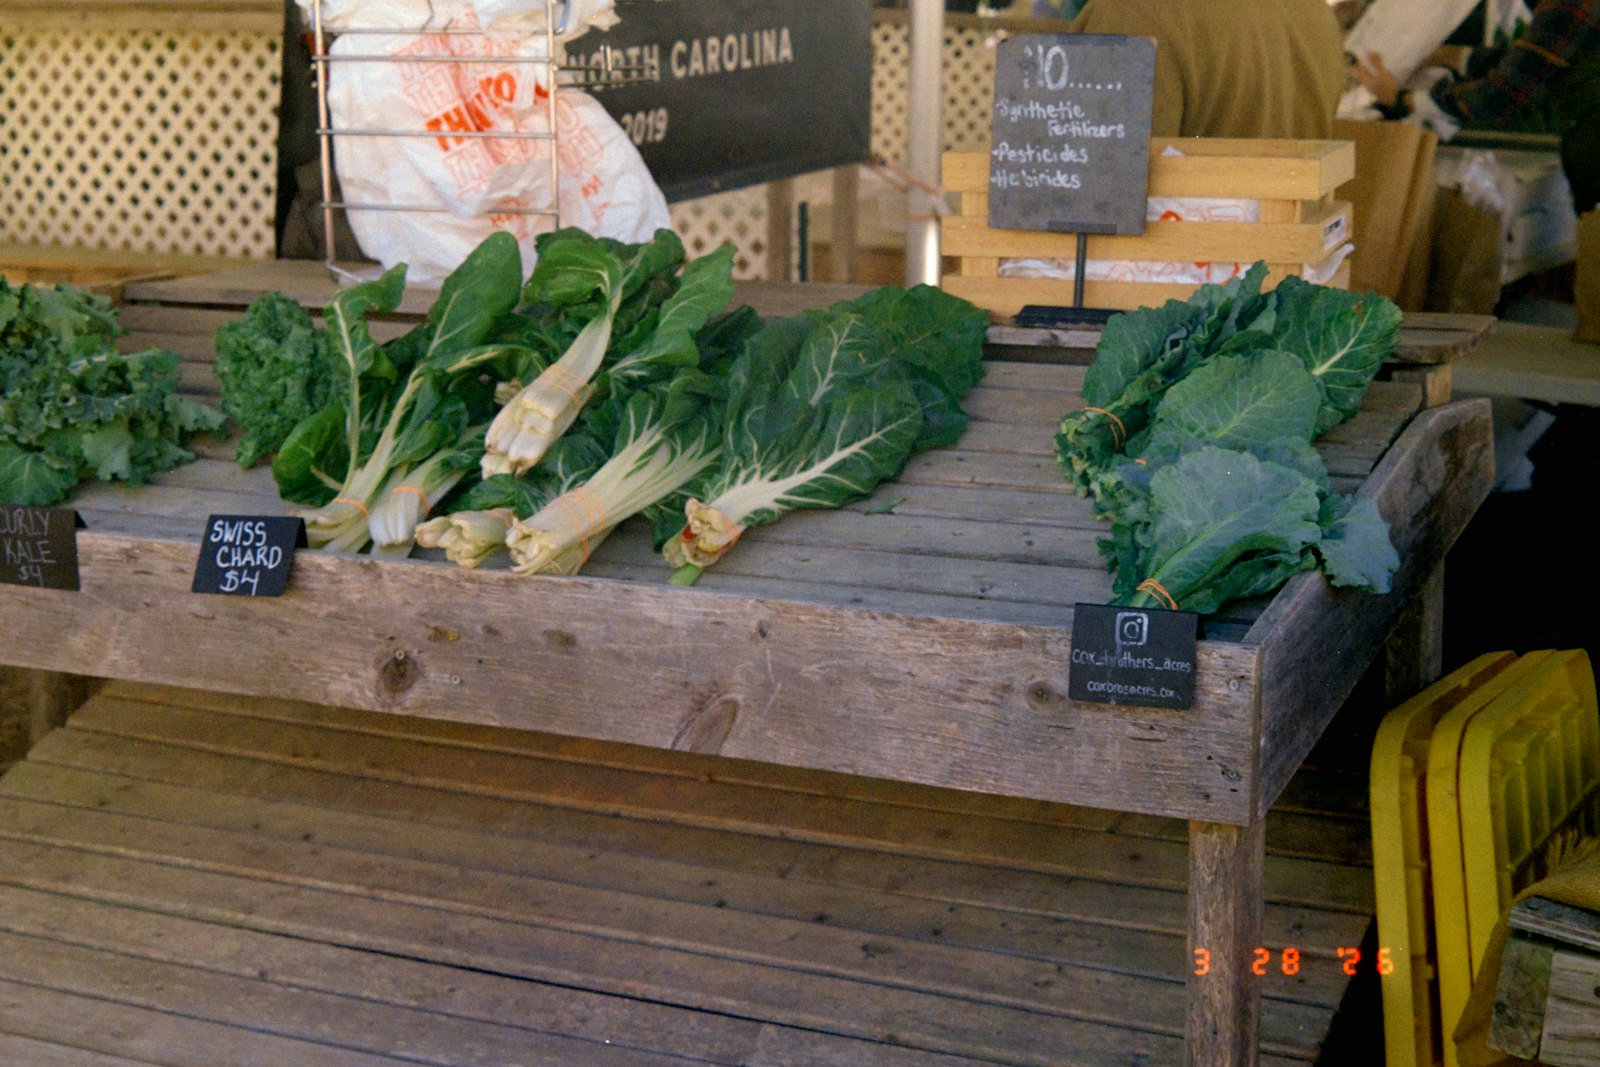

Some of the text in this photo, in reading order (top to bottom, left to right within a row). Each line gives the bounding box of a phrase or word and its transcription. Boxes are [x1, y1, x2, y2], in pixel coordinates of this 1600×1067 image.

[568, 44, 660, 91] NORTH
[671, 27, 793, 79] CAROLINA
[621, 107, 668, 146] 2019
[1048, 119, 1126, 138] Fertilizers
[210, 520, 267, 546] SWISS
[4, 538, 57, 565] KALE
[216, 546, 282, 569] CHARD
[19, 565, 43, 588] $4
[219, 570, 259, 596] $4
